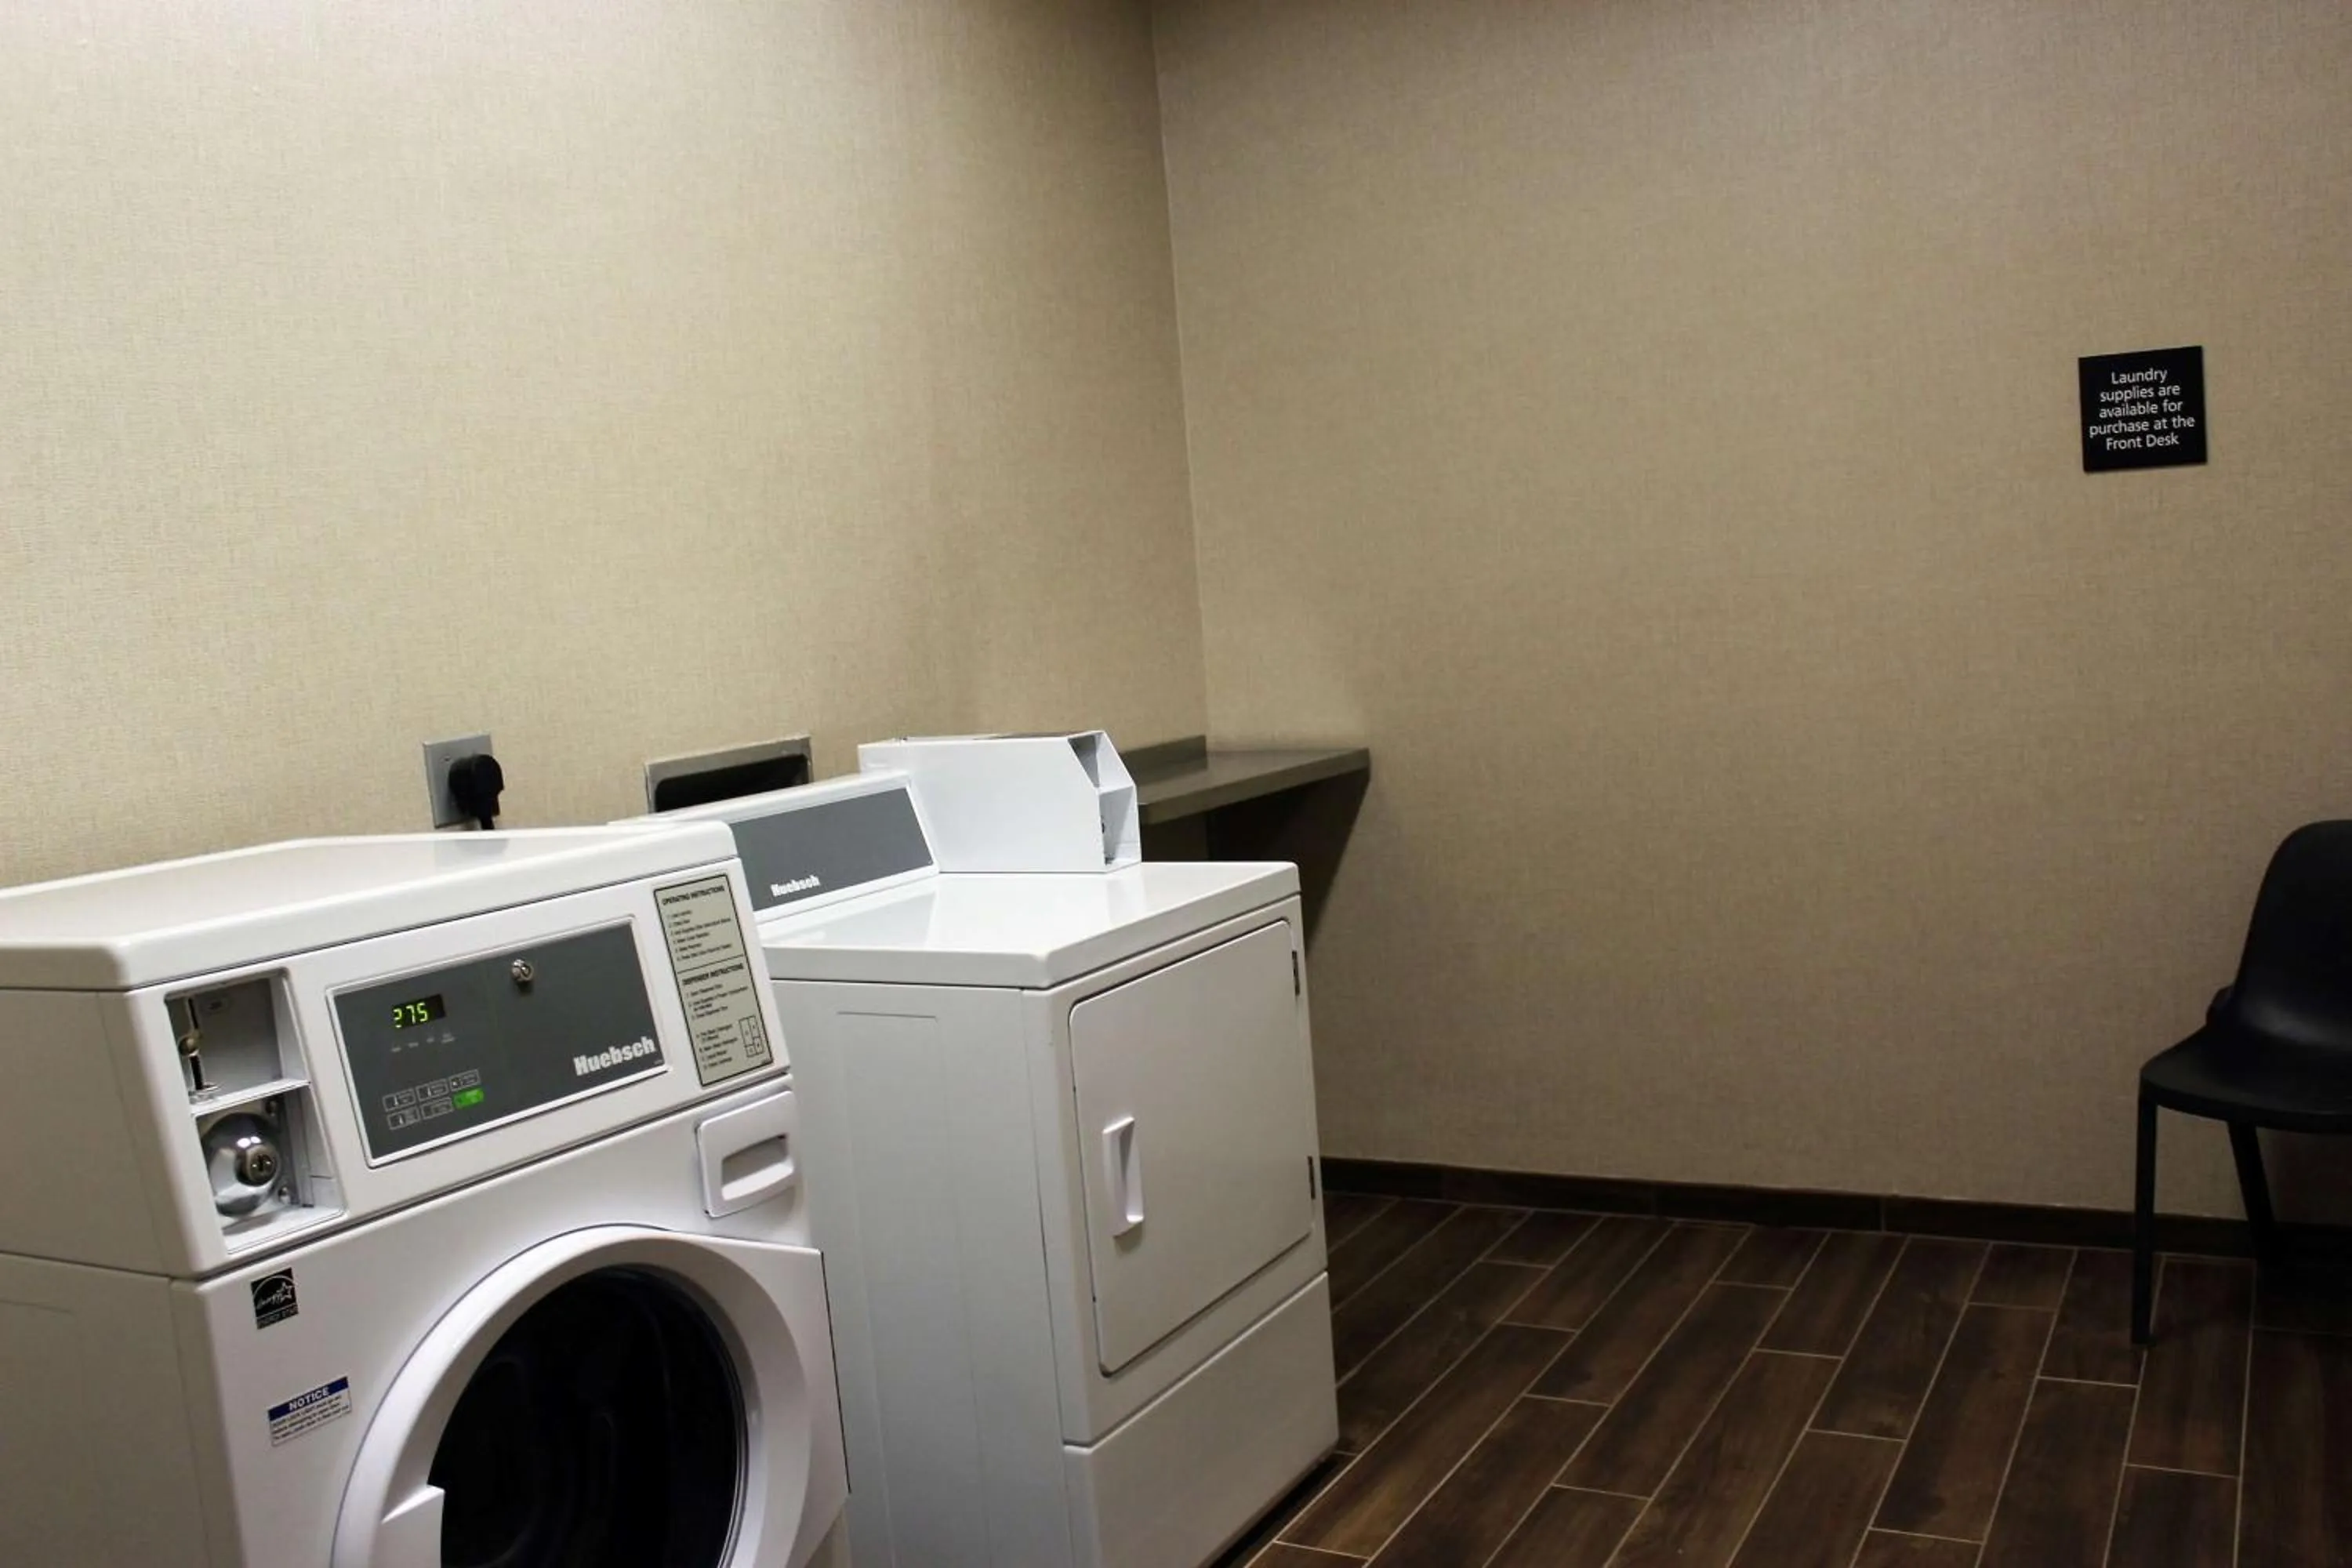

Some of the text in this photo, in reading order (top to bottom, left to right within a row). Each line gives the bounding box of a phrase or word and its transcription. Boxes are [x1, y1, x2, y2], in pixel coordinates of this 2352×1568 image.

[2111, 368, 2168, 384] Laundry
[2100, 384, 2180, 403] supplies are
[2099, 398, 2183, 419] available for
[2089, 415, 2195, 438] purchase at the
[2106, 432, 2180, 451] Front Desk
[573, 1036, 657, 1076] Huebsch
[289, 1386, 330, 1411] NOTICE
